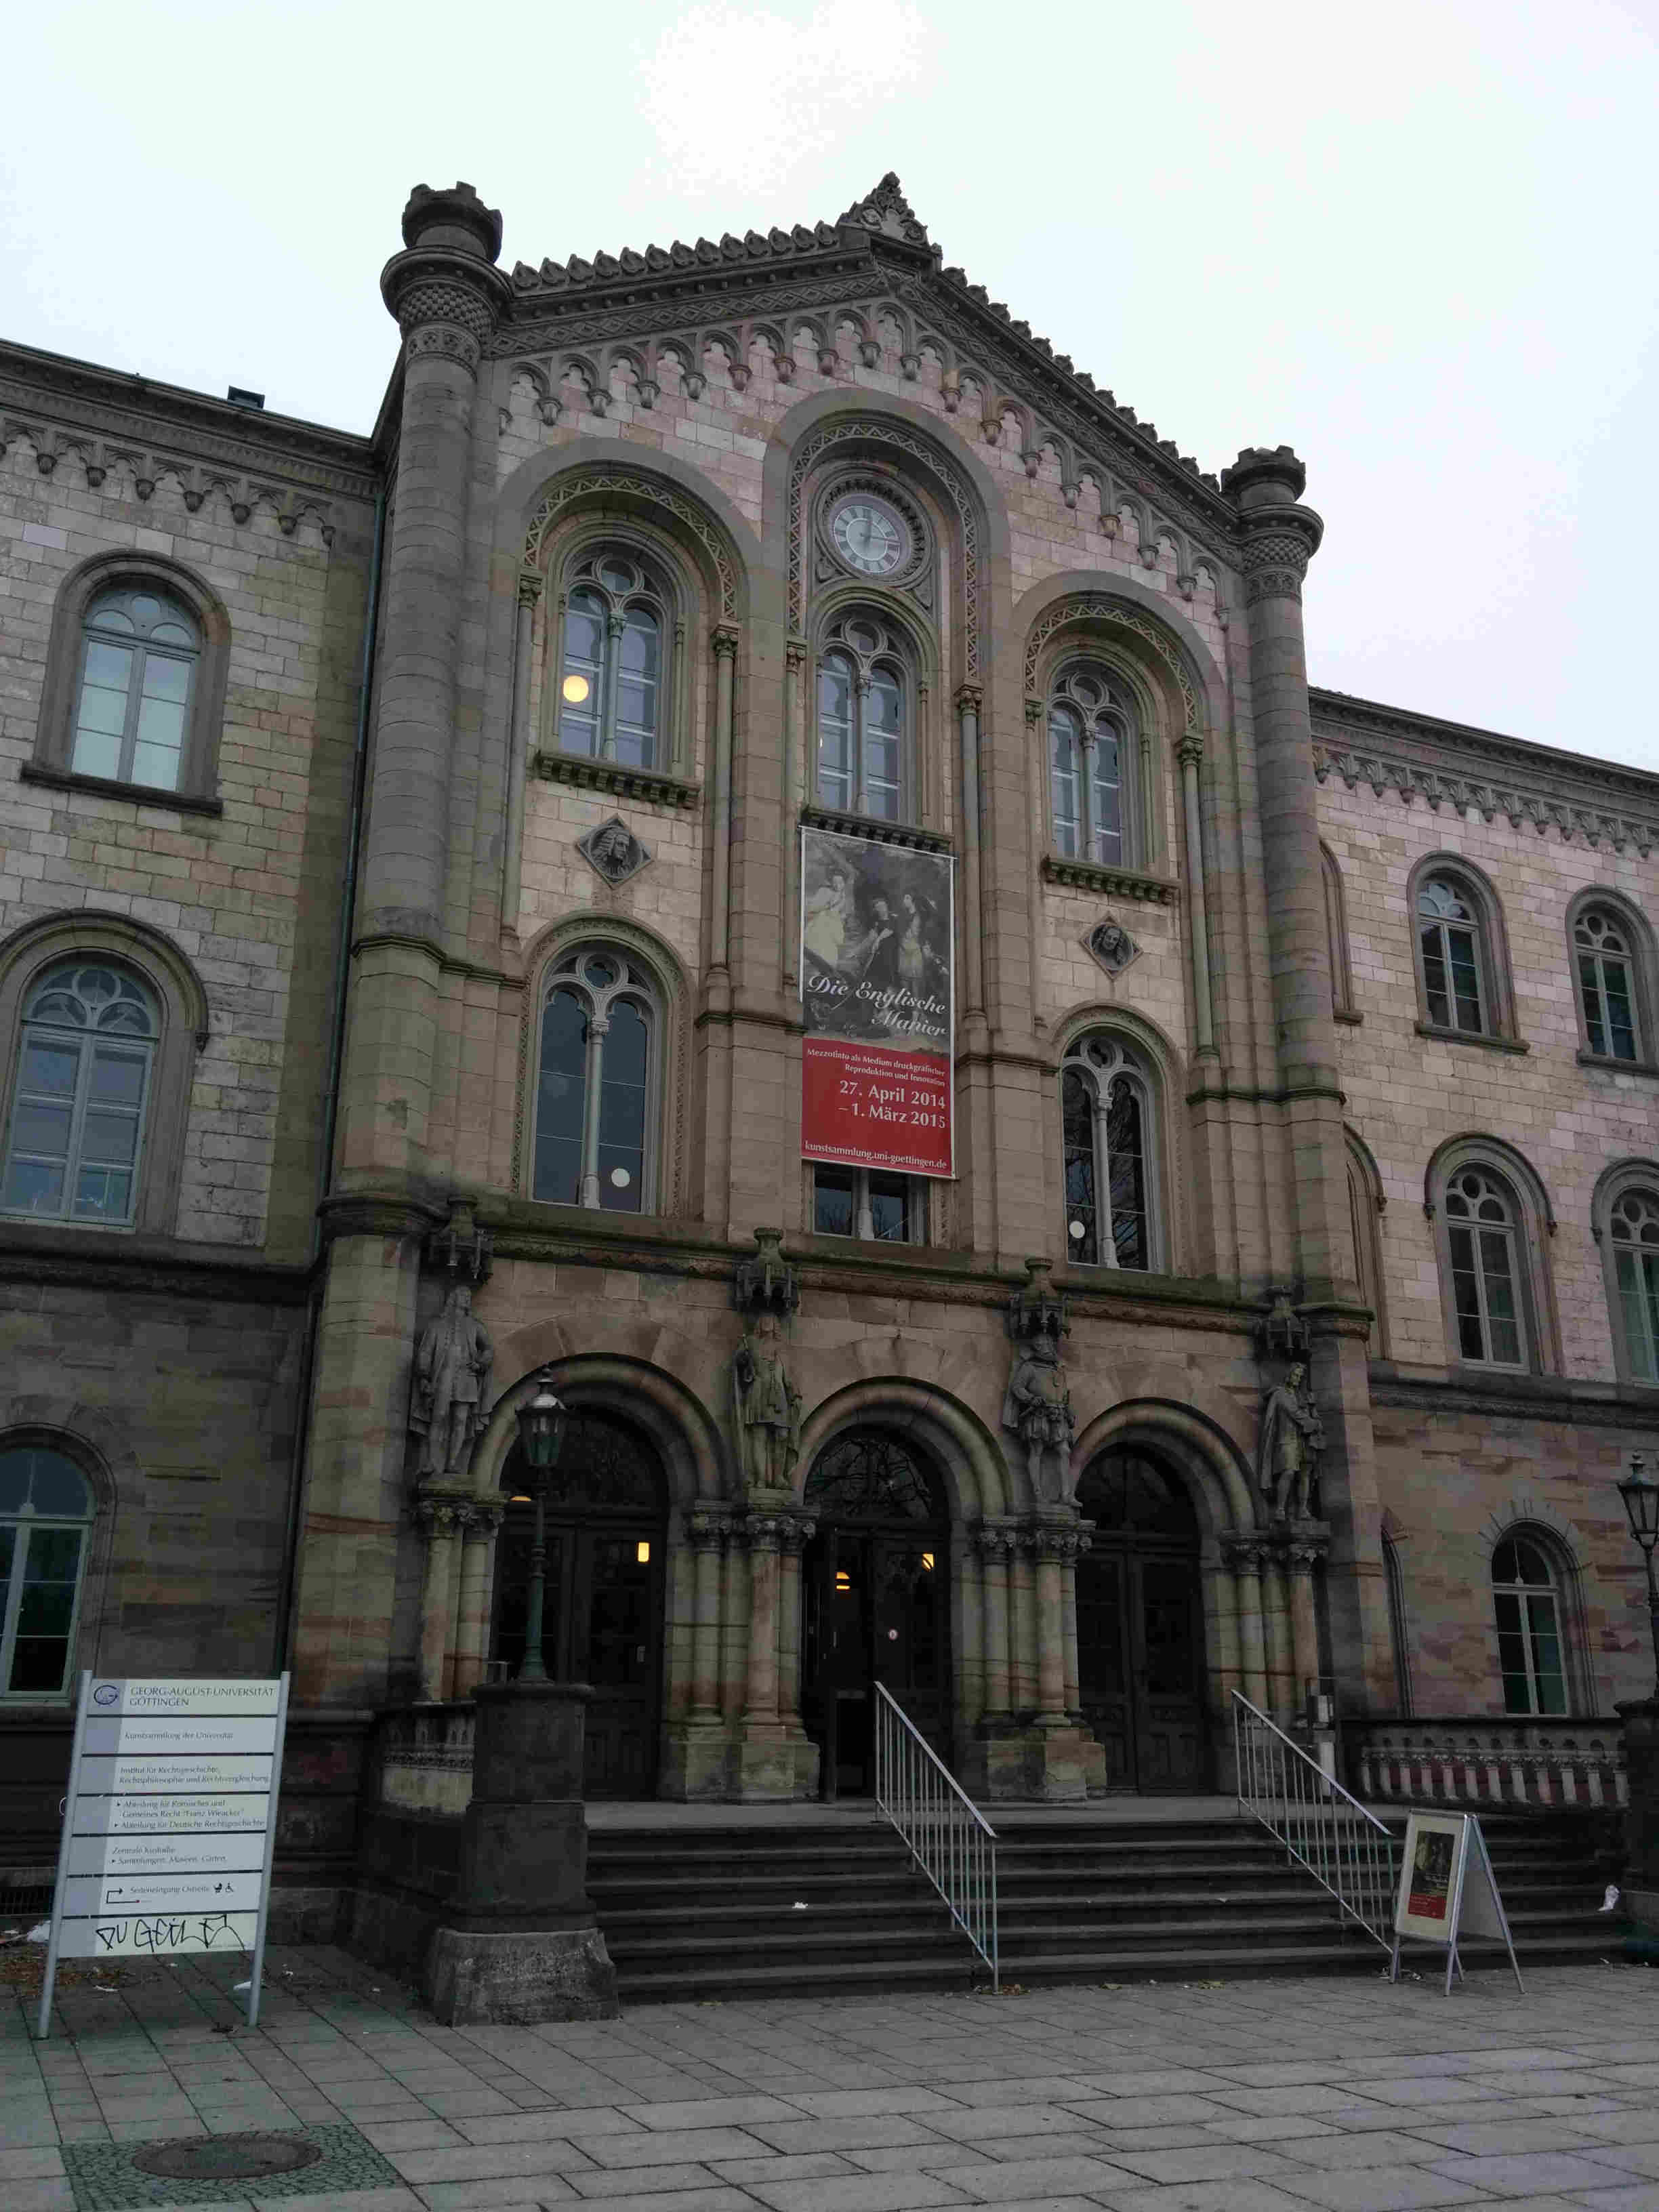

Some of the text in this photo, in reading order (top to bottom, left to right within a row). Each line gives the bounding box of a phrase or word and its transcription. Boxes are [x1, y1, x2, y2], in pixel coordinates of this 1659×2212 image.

[807, 975, 946, 1014] Die Englische
[871, 1010, 949, 1036] Manier
[807, 1048, 945, 1076] Mezzotinto als Medium druckgrafischer
[845, 1063, 893, 1078] Reproduktion
[894, 1072, 909, 1081] und
[840, 1080, 946, 1109] 27. April 2014
[869, 1105, 908, 1123] März
[910, 1111, 946, 1128] 2015
[804, 1141, 947, 1169] kunstsammlung.uni-goettingen.de
[129, 1696, 190, 1706] GÖTTINGEN
